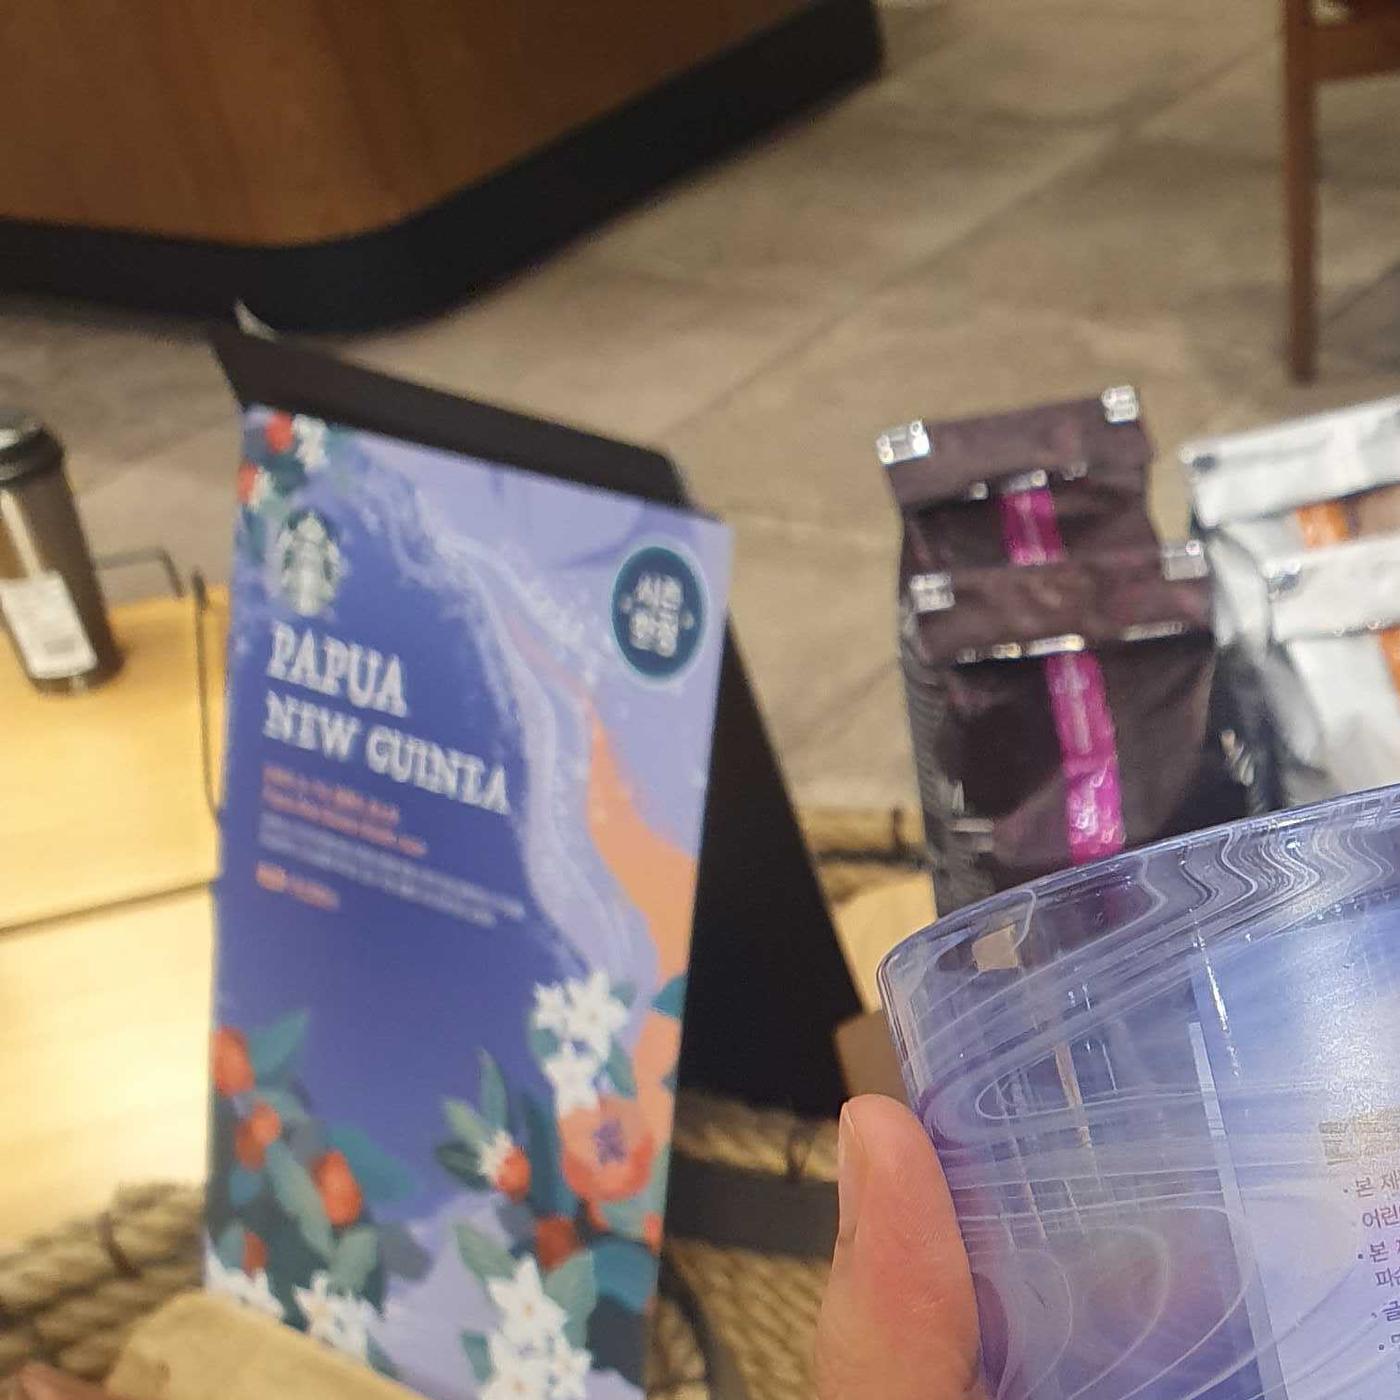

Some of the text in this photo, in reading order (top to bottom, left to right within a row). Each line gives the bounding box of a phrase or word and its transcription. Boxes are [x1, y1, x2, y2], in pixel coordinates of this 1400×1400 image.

[267, 619, 408, 718] PAPUA
[262, 690, 362, 762] NEW
[366, 723, 513, 816] GUINEA
[1355, 1177, 1376, 1198] 본
[1369, 1241, 1389, 1263] 본
